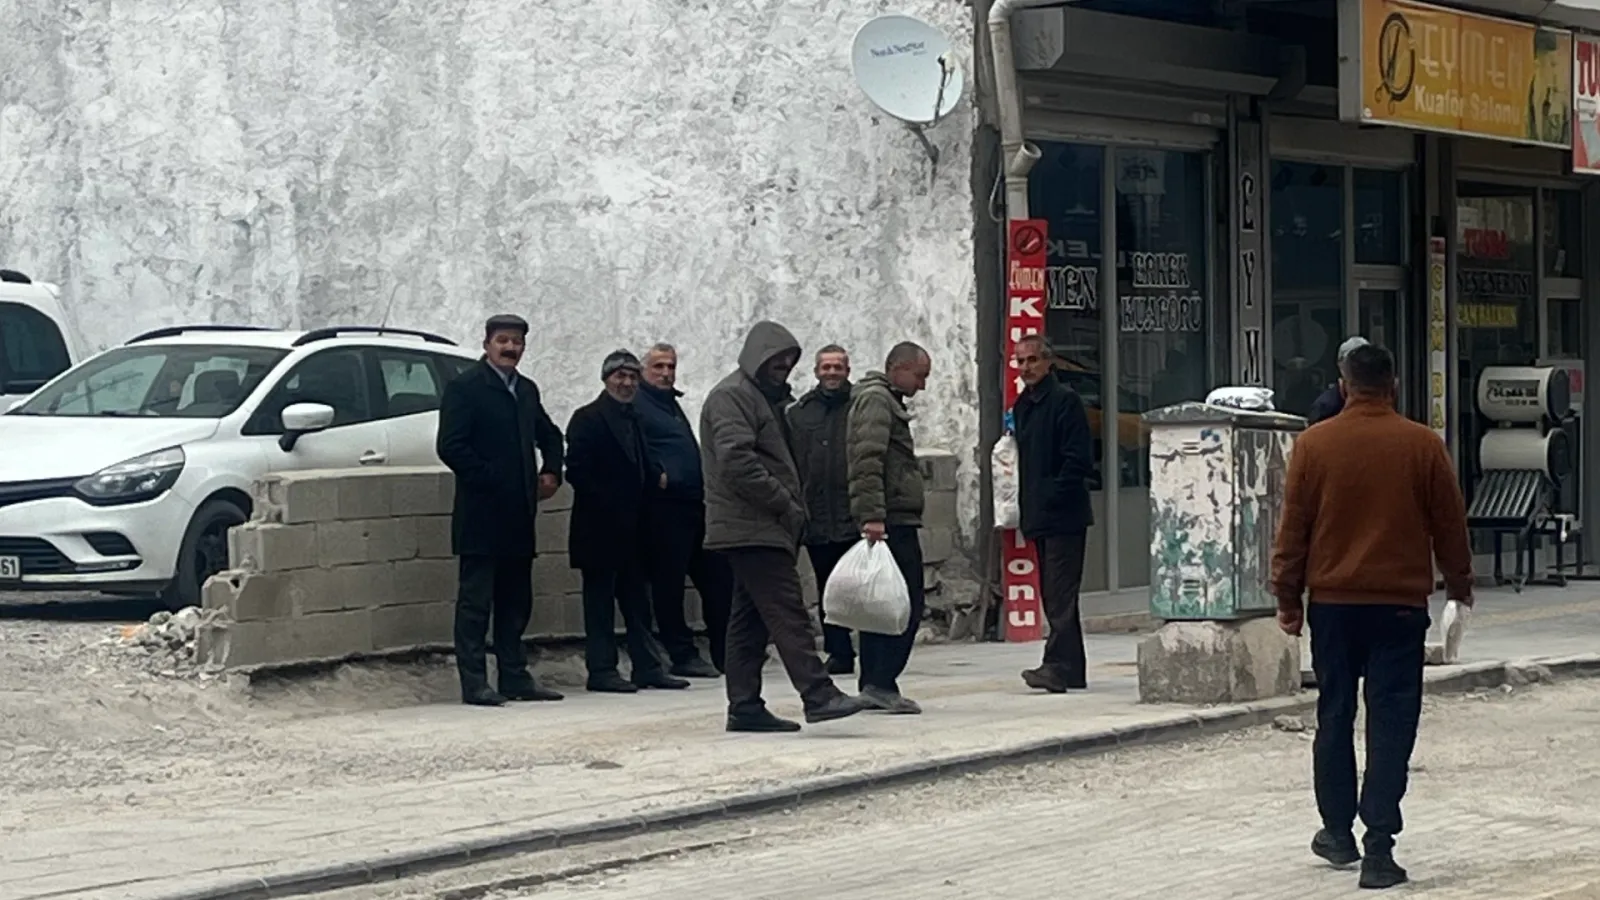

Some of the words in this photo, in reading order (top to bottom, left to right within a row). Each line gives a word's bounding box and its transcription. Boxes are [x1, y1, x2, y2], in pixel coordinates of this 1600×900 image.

[1577, 41, 1600, 97] TU
[1414, 85, 1464, 117] Kuaför
[1470, 92, 1520, 125] Salonu
[1132, 251, 1191, 288] ERKEK
[1120, 290, 1203, 332] KUAFÖRÜ
